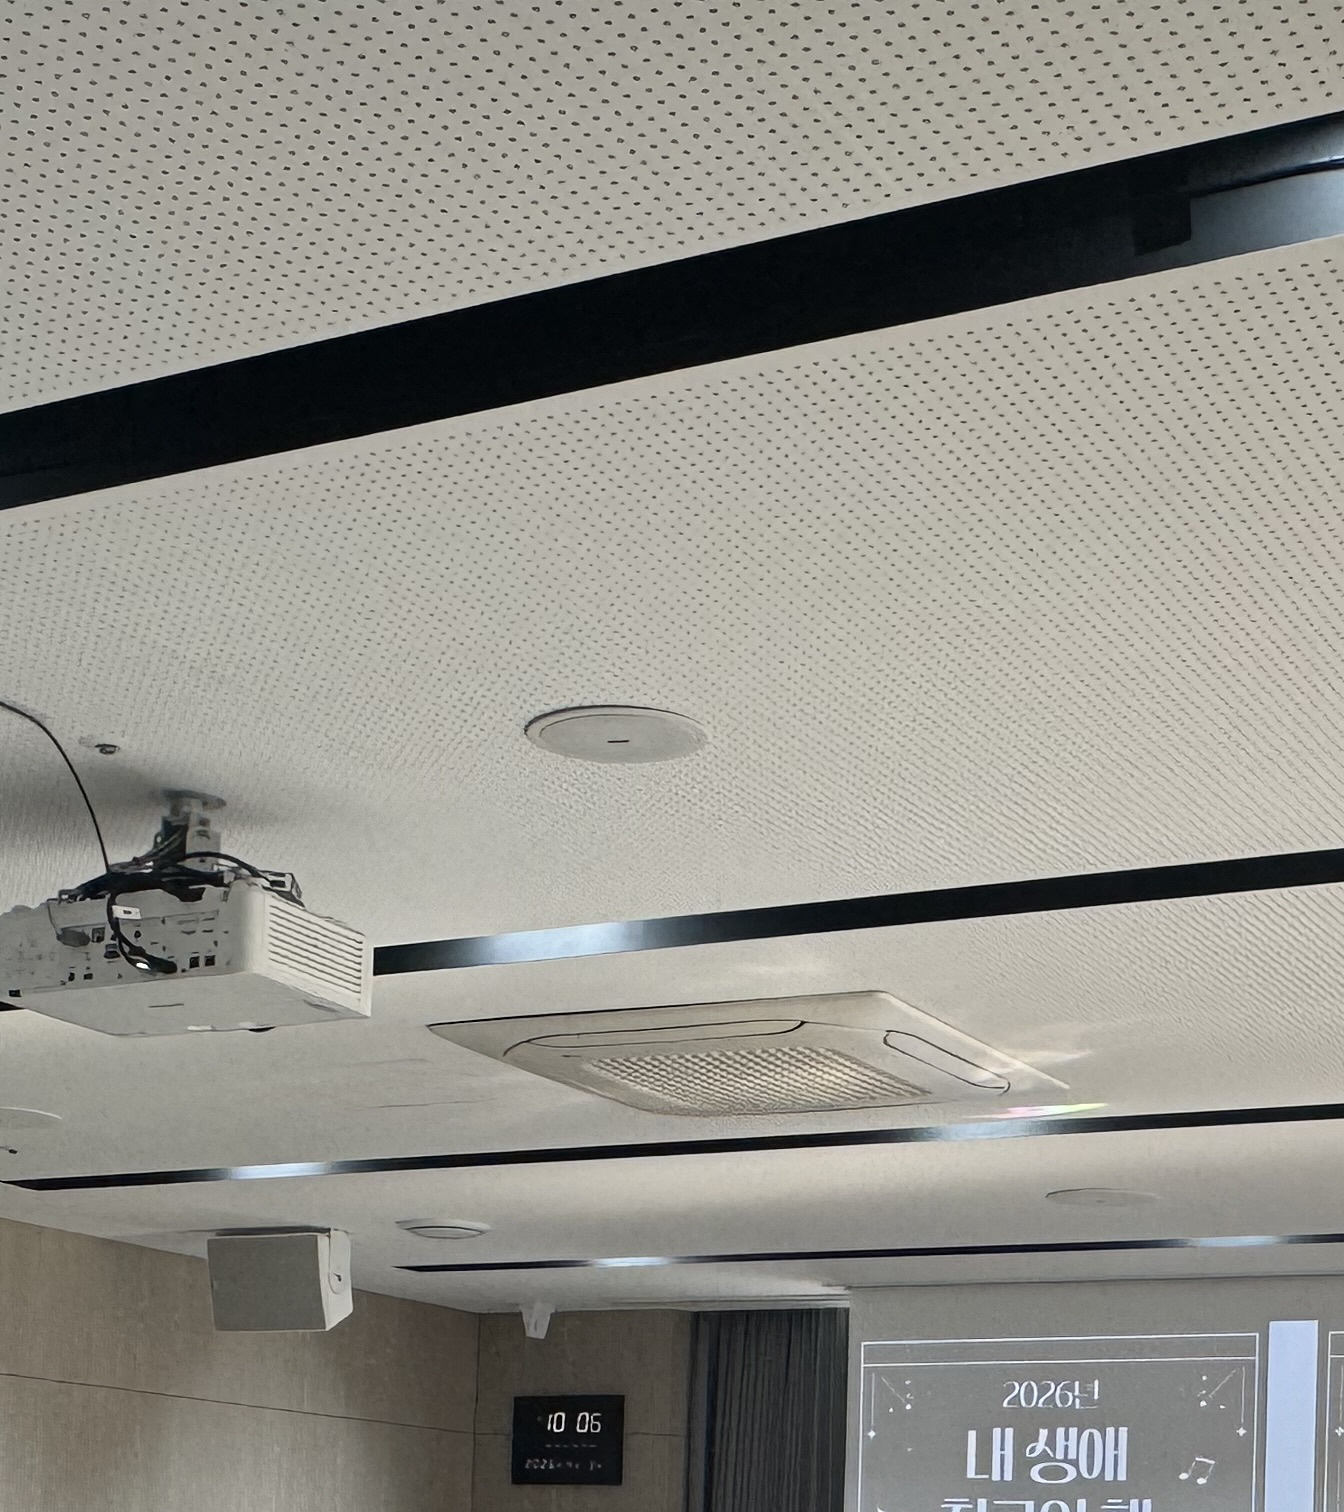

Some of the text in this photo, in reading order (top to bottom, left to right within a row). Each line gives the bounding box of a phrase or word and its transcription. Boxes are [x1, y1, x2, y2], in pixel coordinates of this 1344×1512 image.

[1002, 1379, 1100, 1409] 2026년
[547, 1411, 602, 1433] 10 06
[966, 1426, 1129, 1484] 내 생애
